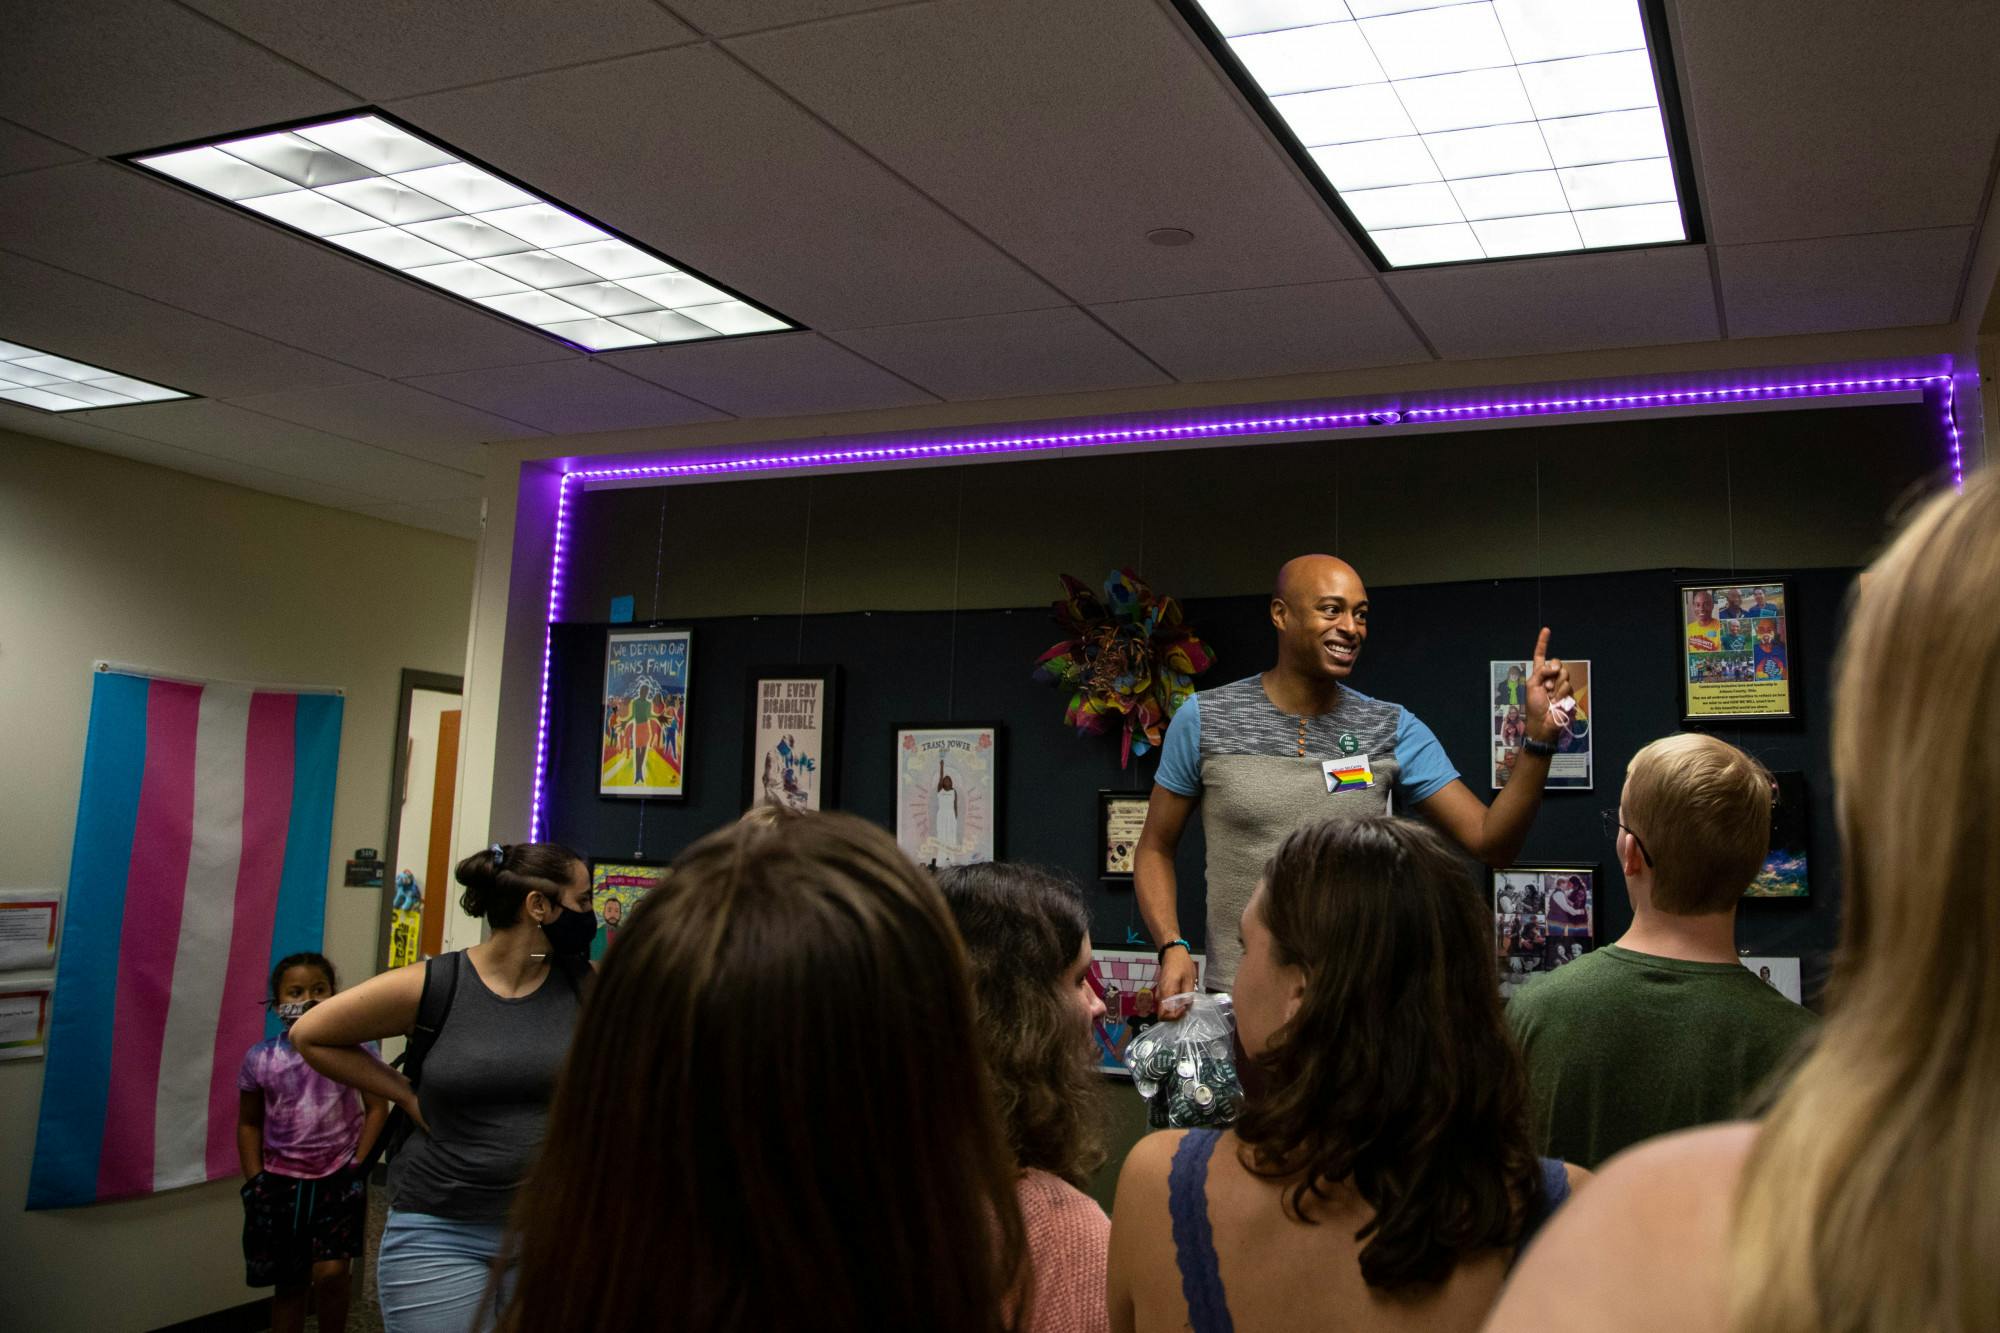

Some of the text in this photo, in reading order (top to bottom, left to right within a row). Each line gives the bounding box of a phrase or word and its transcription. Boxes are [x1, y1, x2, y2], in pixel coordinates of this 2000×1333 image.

[610, 658, 685, 676] TRANS FAMILY
[763, 682, 818, 698] NOT EVERY
[763, 698, 817, 714] DISABILITY
[762, 714, 817, 730] IS VISIBLE.
